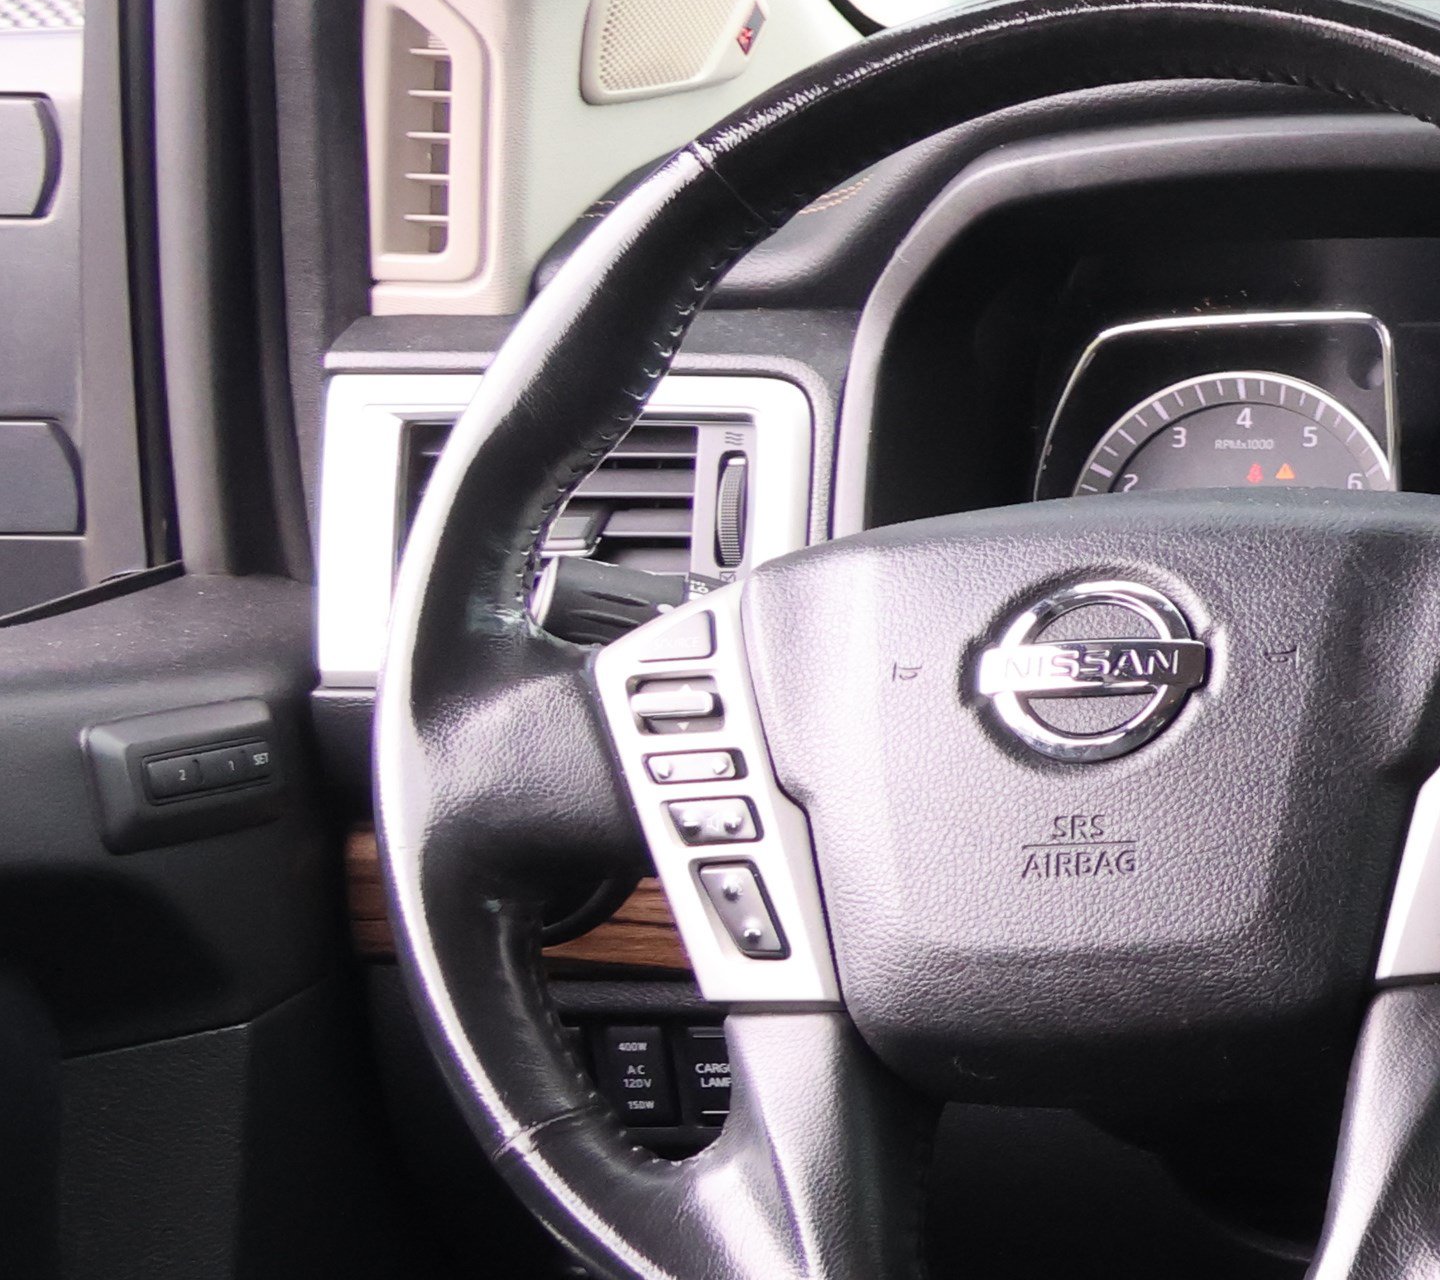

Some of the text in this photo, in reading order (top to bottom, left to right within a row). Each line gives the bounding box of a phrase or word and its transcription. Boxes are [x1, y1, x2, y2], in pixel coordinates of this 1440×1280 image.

[1236, 408, 1253, 428] 4
[1172, 427, 1187, 448] 3
[1303, 427, 1318, 447] 5
[1003, 648, 1179, 679] NISSAN
[253, 752, 269, 766] SET
[1052, 814, 1106, 839] SRS
[1021, 850, 1136, 879] AIRBAG
[618, 1042, 647, 1051] 400W
[695, 1063, 730, 1073] CARG
[623, 1078, 652, 1088] 120V
[627, 1100, 655, 1110] 150W
